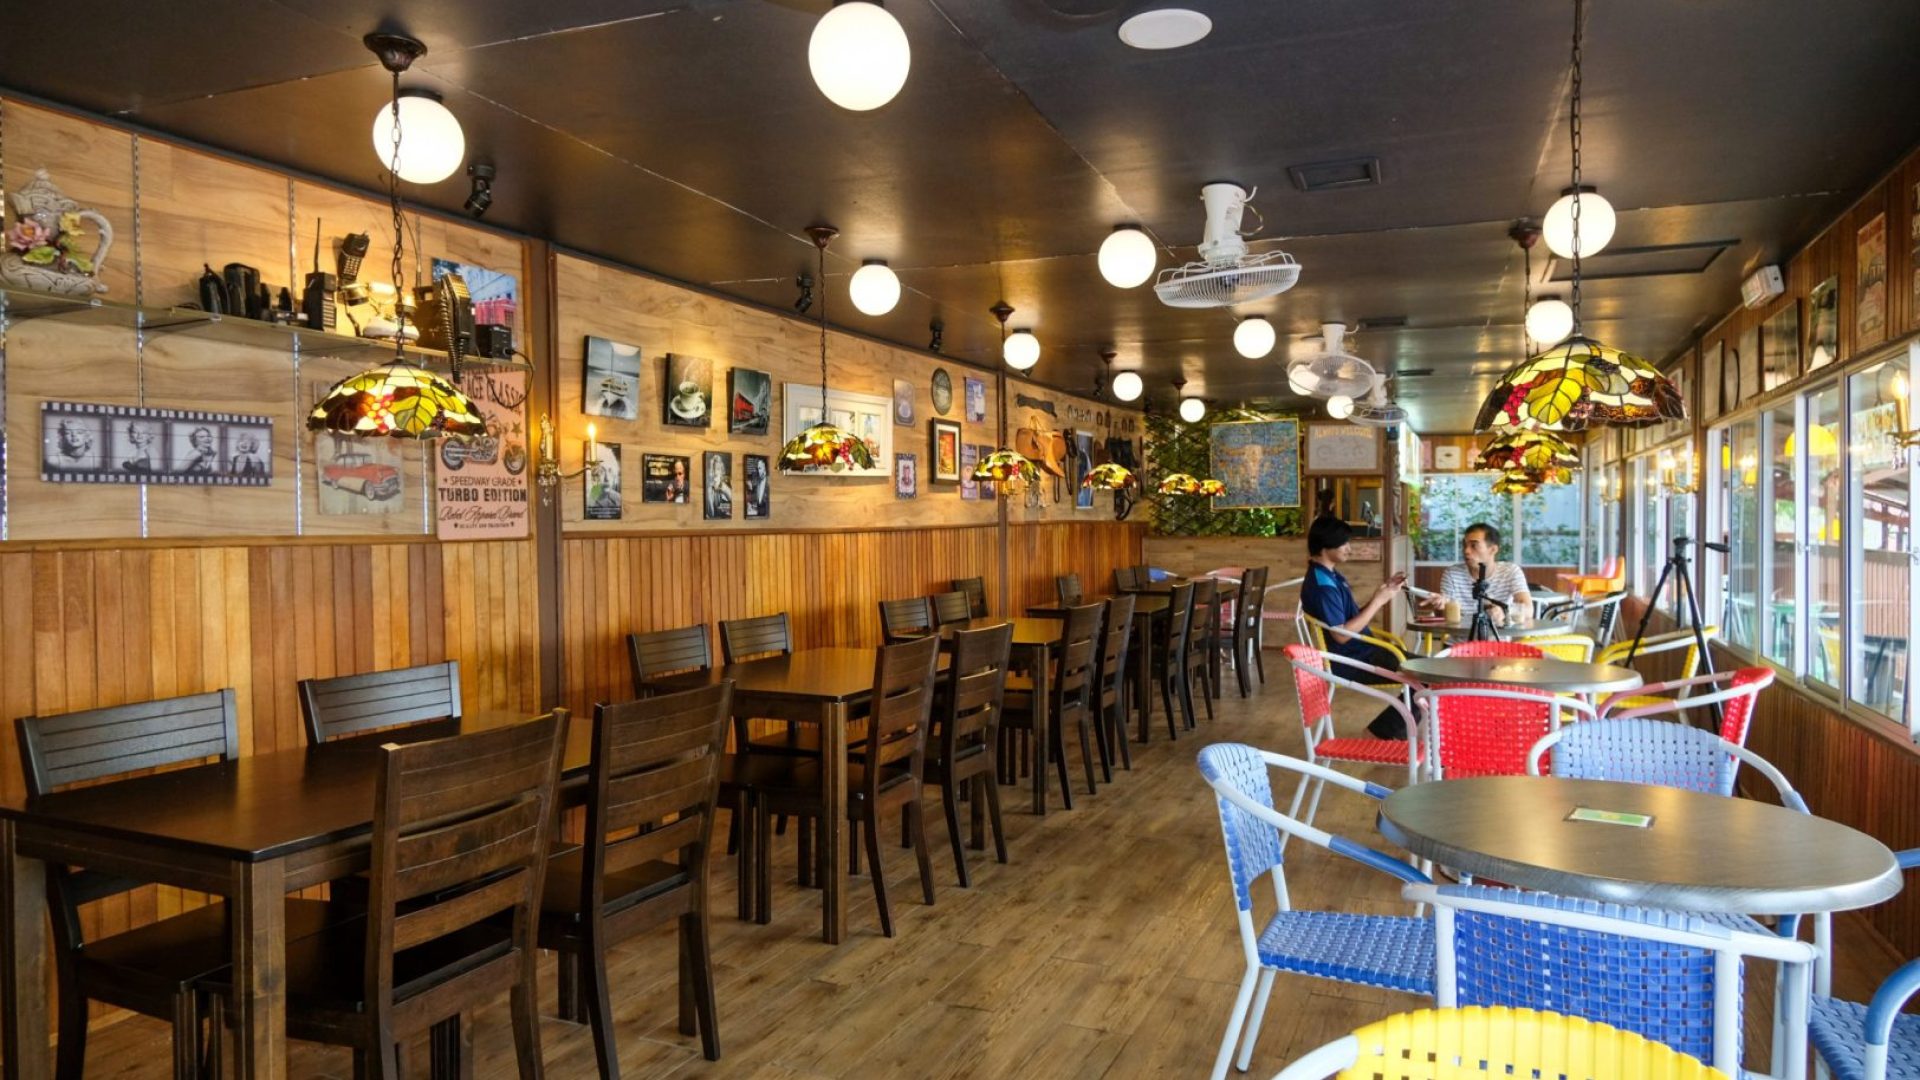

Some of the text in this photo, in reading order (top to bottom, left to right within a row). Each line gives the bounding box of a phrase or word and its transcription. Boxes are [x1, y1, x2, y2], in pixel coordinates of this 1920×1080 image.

[450, 476, 516, 487] SPEEDWAY GRADE
[438, 488, 527, 502] TURBO EDITION
